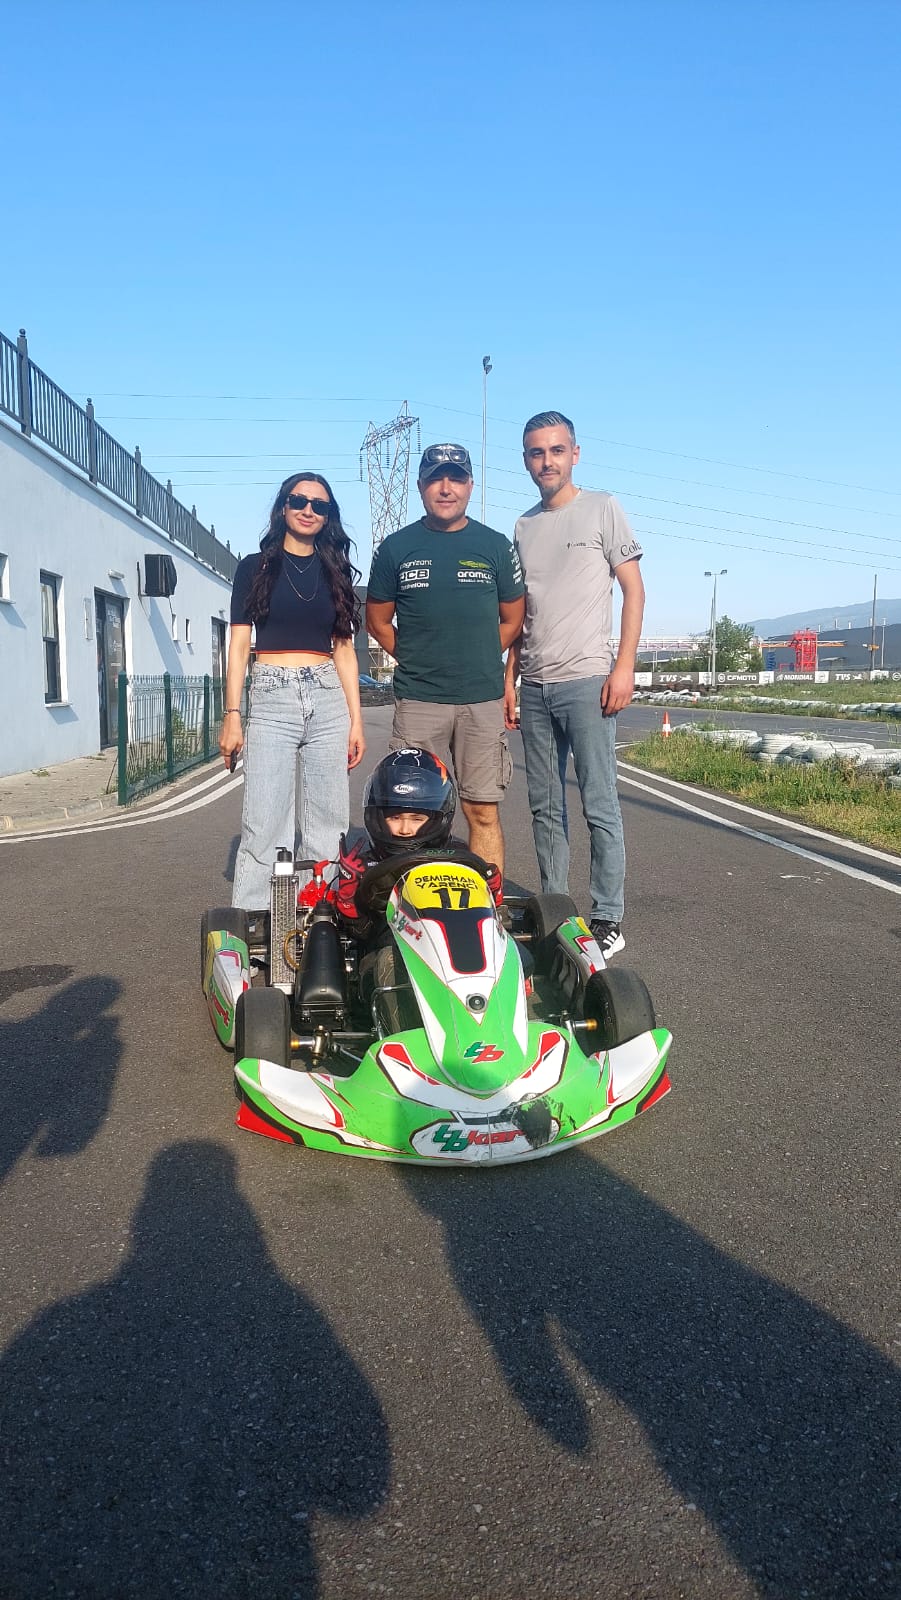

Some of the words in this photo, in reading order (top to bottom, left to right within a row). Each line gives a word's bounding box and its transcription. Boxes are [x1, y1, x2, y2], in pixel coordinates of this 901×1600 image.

[400, 570, 429, 581] JCB
[835, 673, 851, 681] TVS
[415, 875, 476, 885] DEMIRHAN
[417, 881, 478, 890] YARENCI
[432, 888, 471, 909] 17
